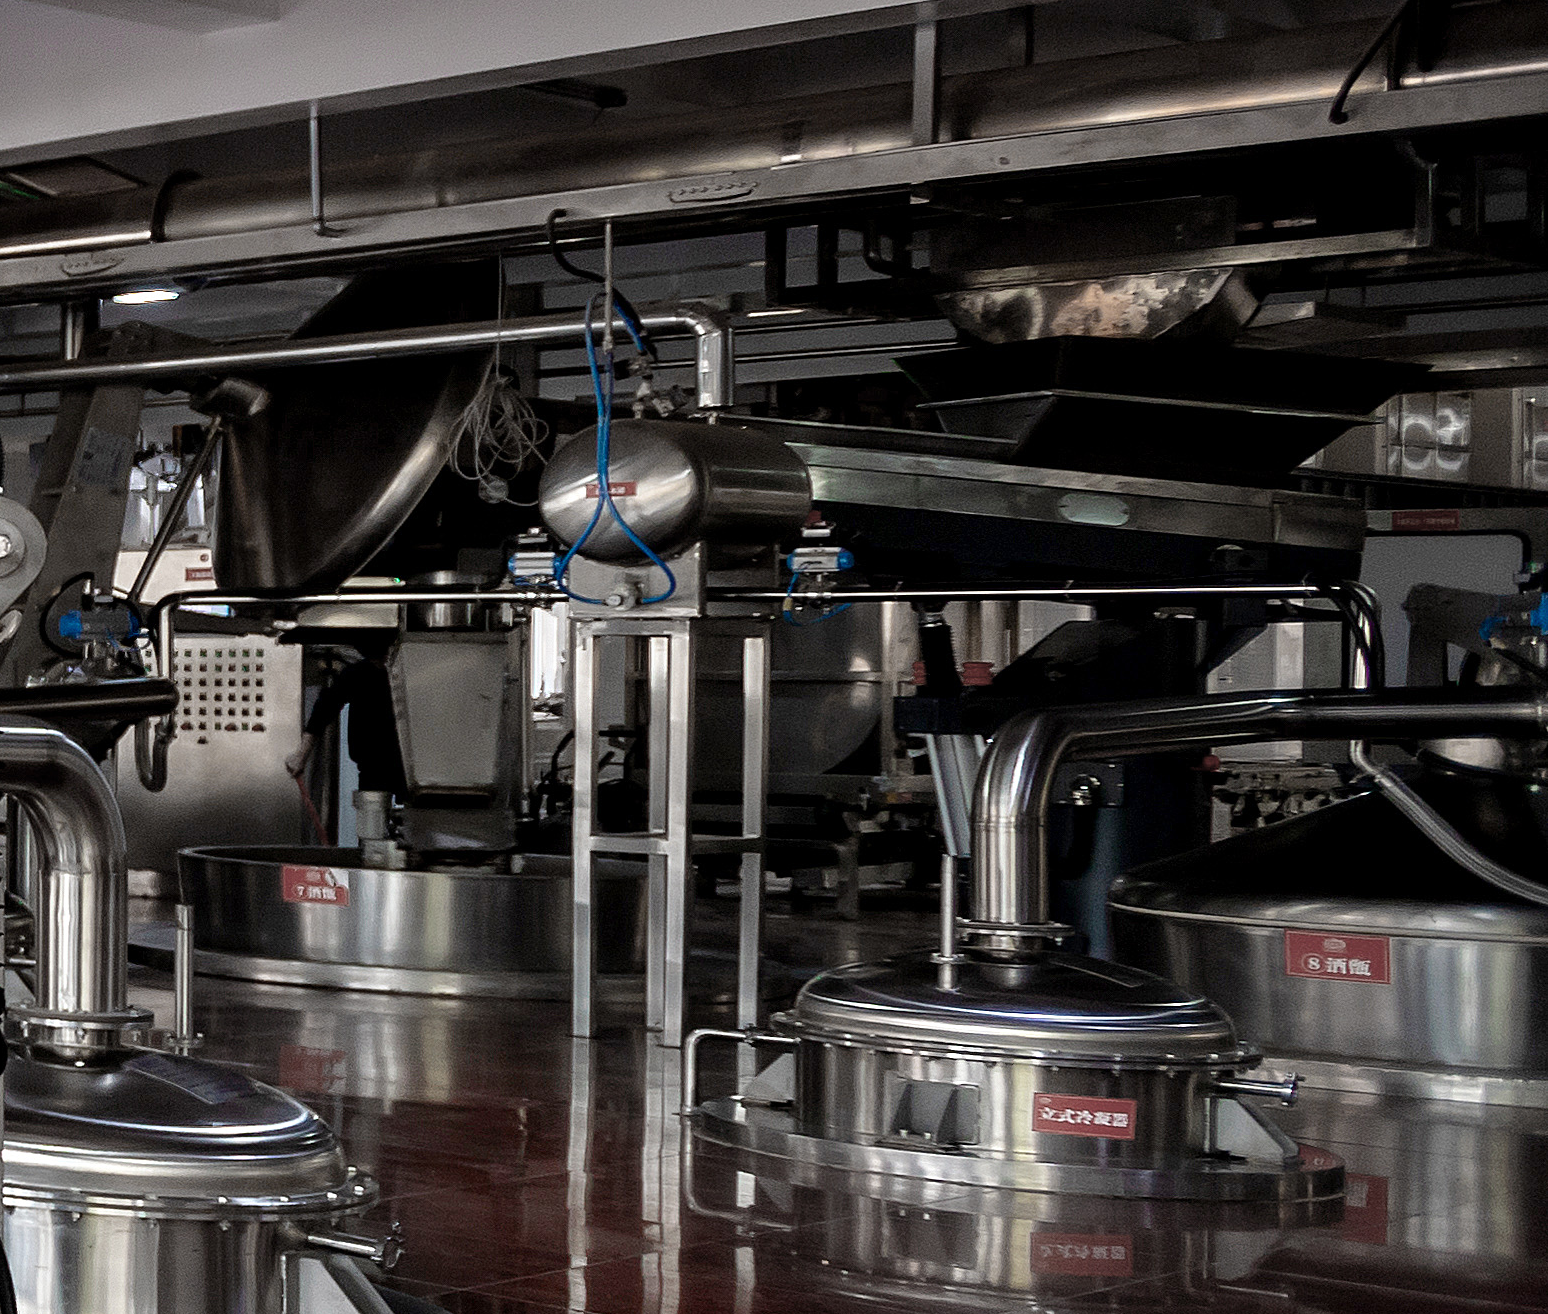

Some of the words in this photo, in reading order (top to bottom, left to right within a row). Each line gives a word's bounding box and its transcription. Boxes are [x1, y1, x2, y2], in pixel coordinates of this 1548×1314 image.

[1038, 1106, 1129, 1128] 立式冷凝器
